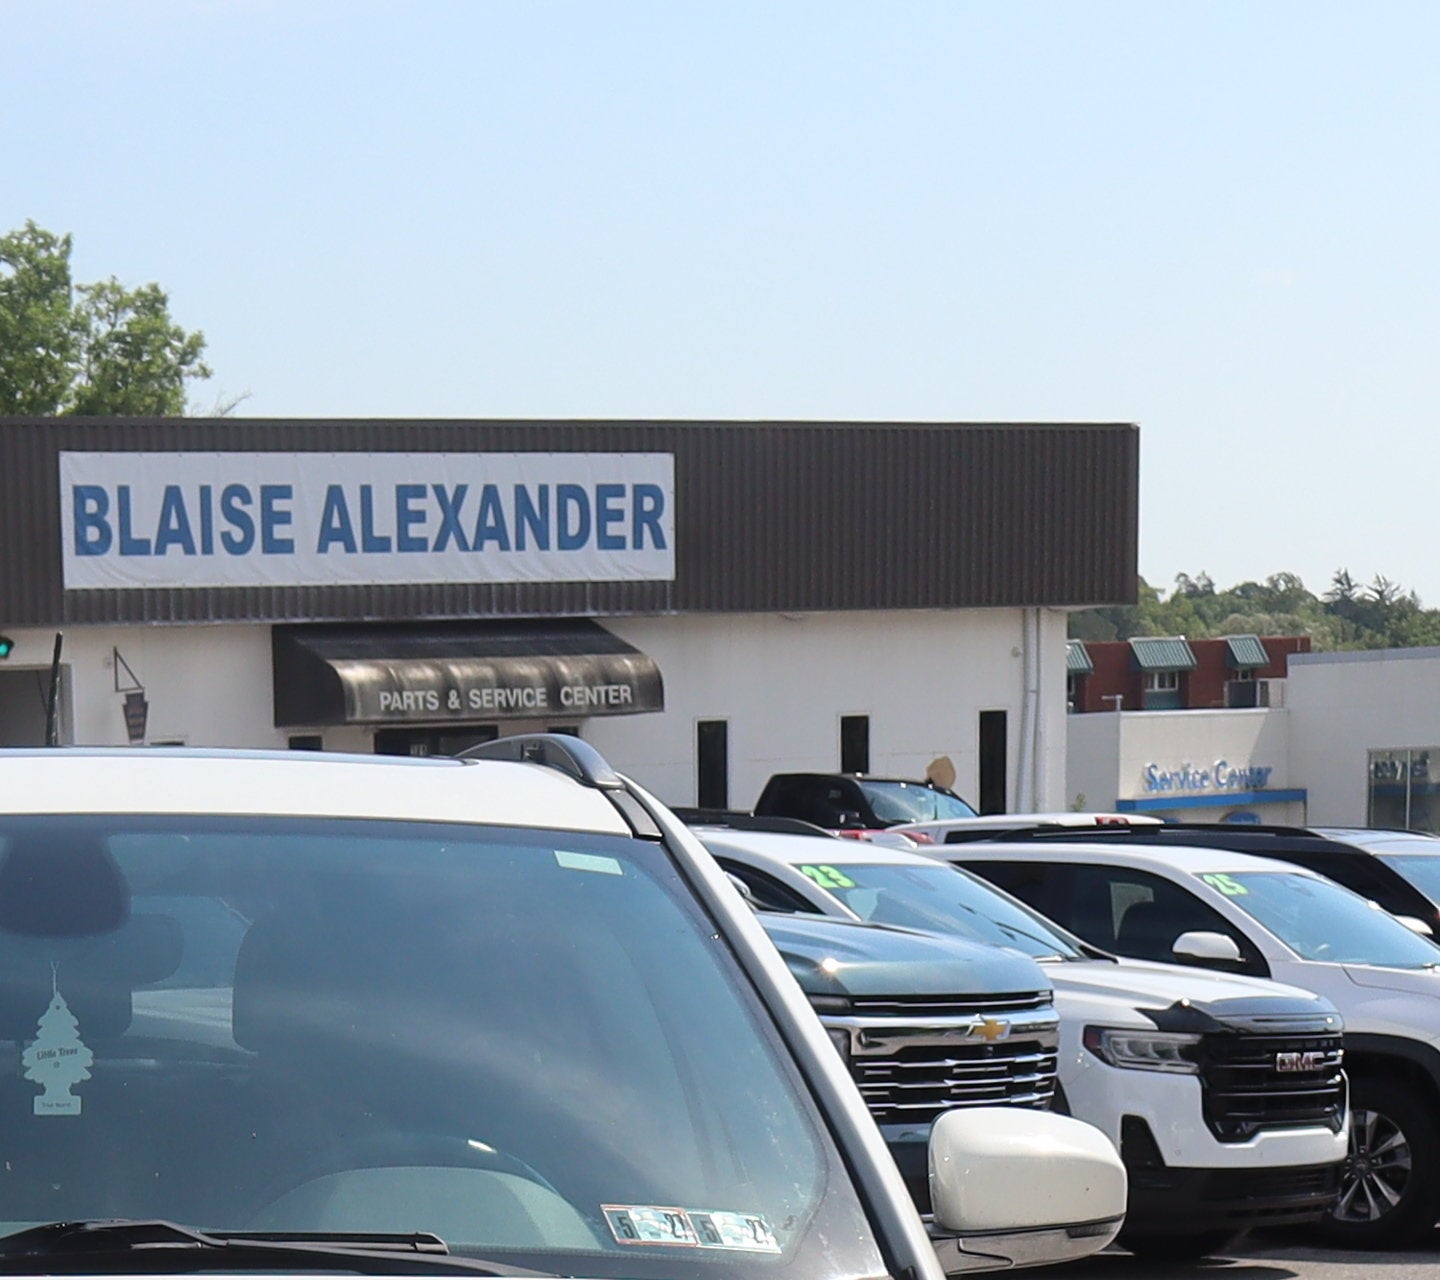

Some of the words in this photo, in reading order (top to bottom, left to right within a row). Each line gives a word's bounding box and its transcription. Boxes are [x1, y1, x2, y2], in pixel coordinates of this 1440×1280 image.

[72, 484, 295, 557] BLAISE
[317, 483, 668, 553] ALEXANDER
[379, 690, 440, 712] PARTS
[447, 689, 461, 710] &
[469, 688, 548, 710] SERVICE
[560, 685, 633, 706] CENTER
[1146, 763, 1210, 791] Service
[1214, 760, 1272, 789] Center
[801, 864, 856, 889] 23
[1276, 1052, 1326, 1072] GMC
[619, 1216, 635, 1239] 5
[699, 1220, 717, 1244] 5
